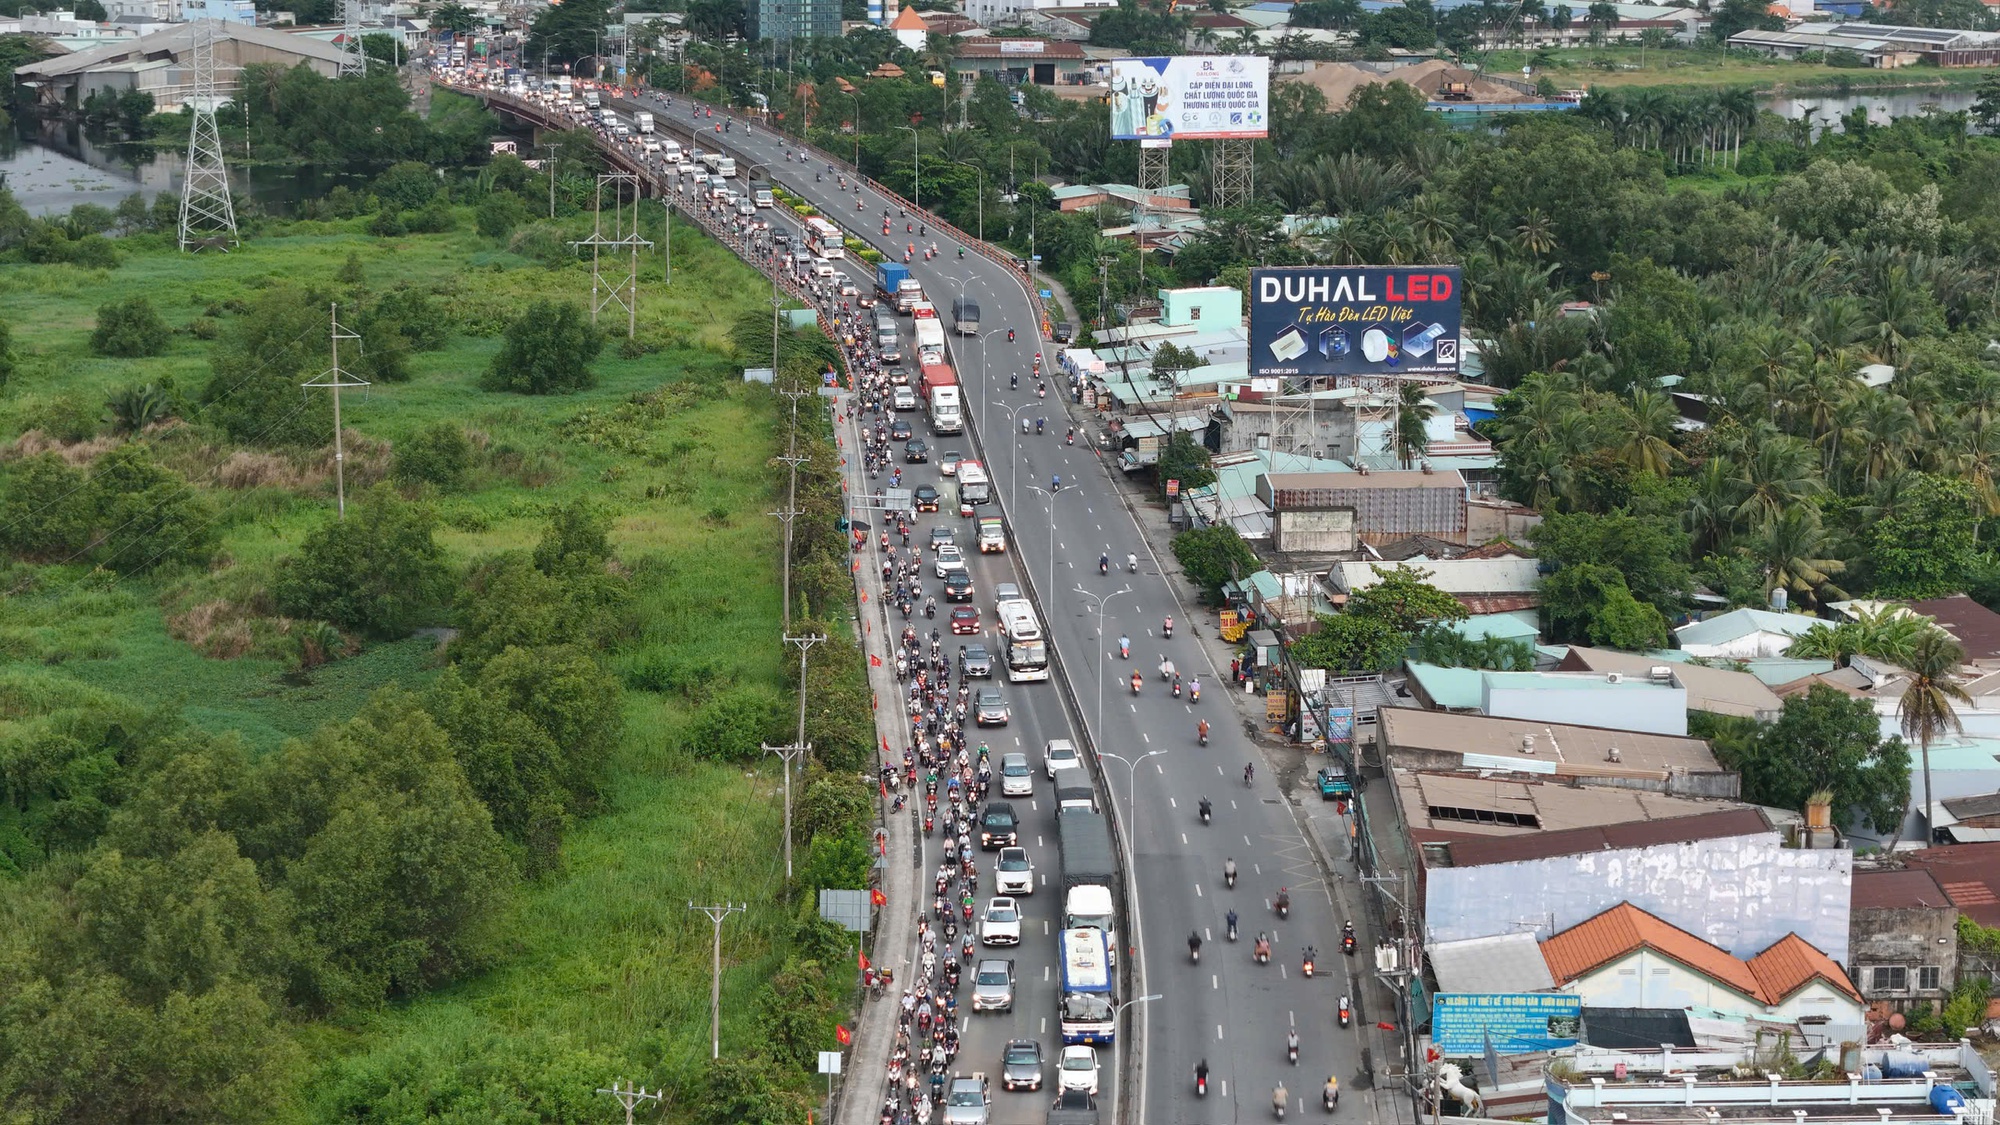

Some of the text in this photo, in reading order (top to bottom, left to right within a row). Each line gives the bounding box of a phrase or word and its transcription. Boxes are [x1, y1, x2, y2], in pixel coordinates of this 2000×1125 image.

[1260, 274, 1453, 302] DUHAL LED
[1298, 306, 1414, 324] Tự Hào Đèn LED Việt
